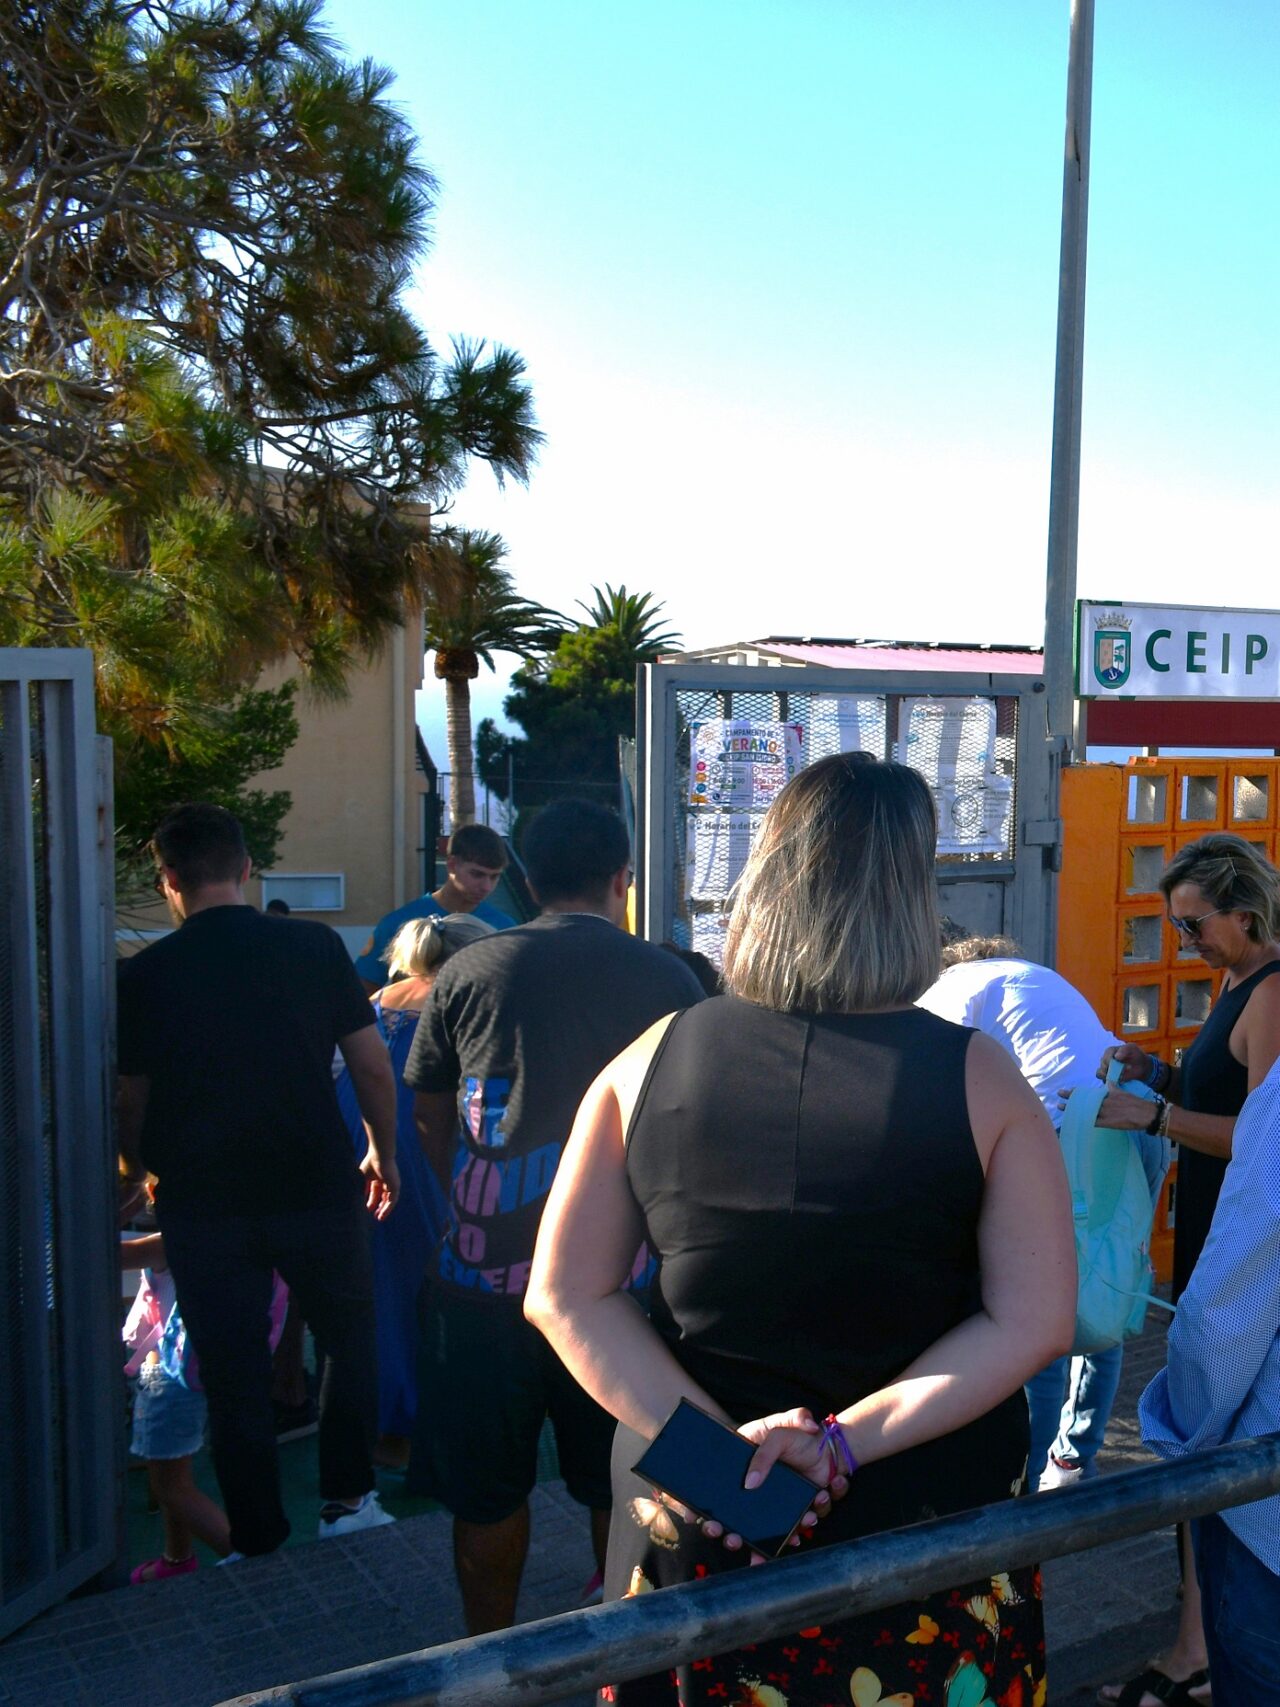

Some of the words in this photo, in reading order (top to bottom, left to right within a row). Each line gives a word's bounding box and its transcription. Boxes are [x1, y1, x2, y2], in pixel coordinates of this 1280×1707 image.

[723, 737, 777, 752] VERANO
[705, 821, 736, 830] Horario
[738, 821, 750, 830] del
